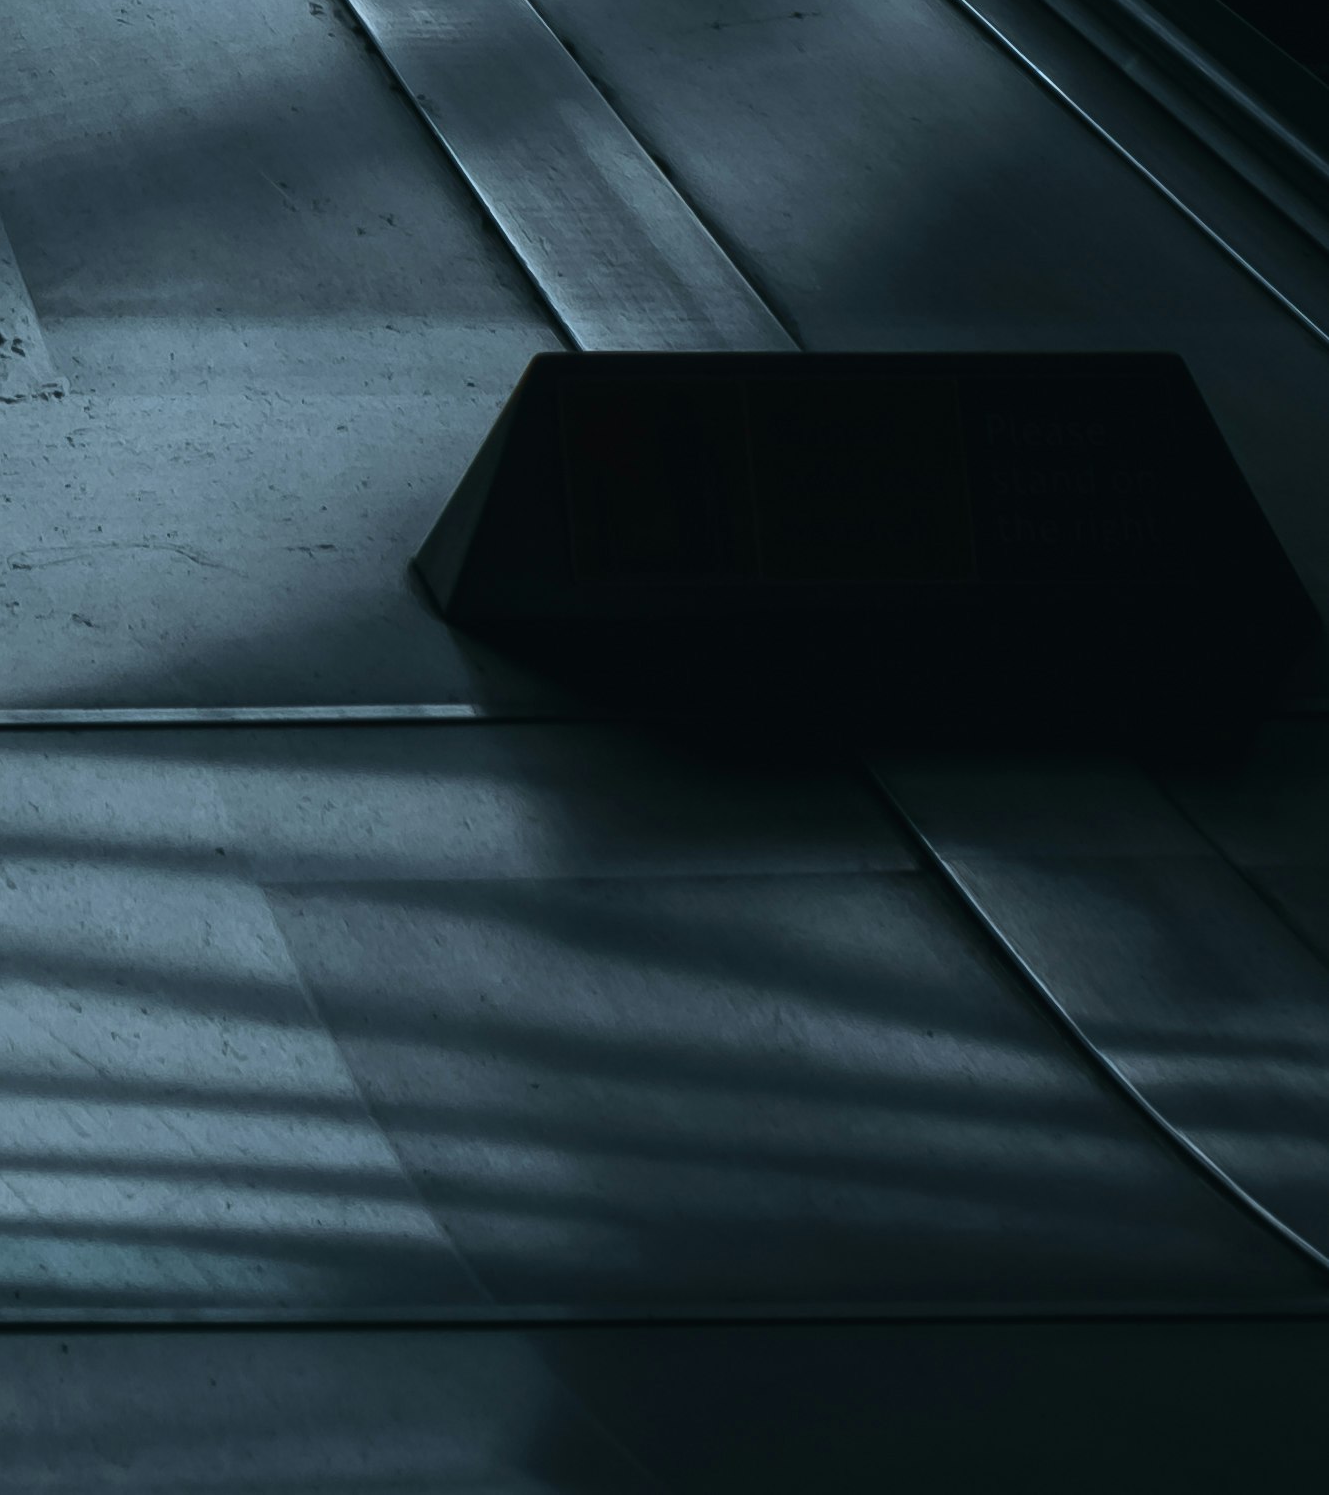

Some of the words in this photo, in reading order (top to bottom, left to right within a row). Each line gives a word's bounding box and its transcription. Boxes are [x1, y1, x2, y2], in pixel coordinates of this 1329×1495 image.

[985, 414, 1107, 447] Please
[991, 462, 1096, 497] stand
[997, 511, 1061, 546] the
[1074, 511, 1160, 552] right
